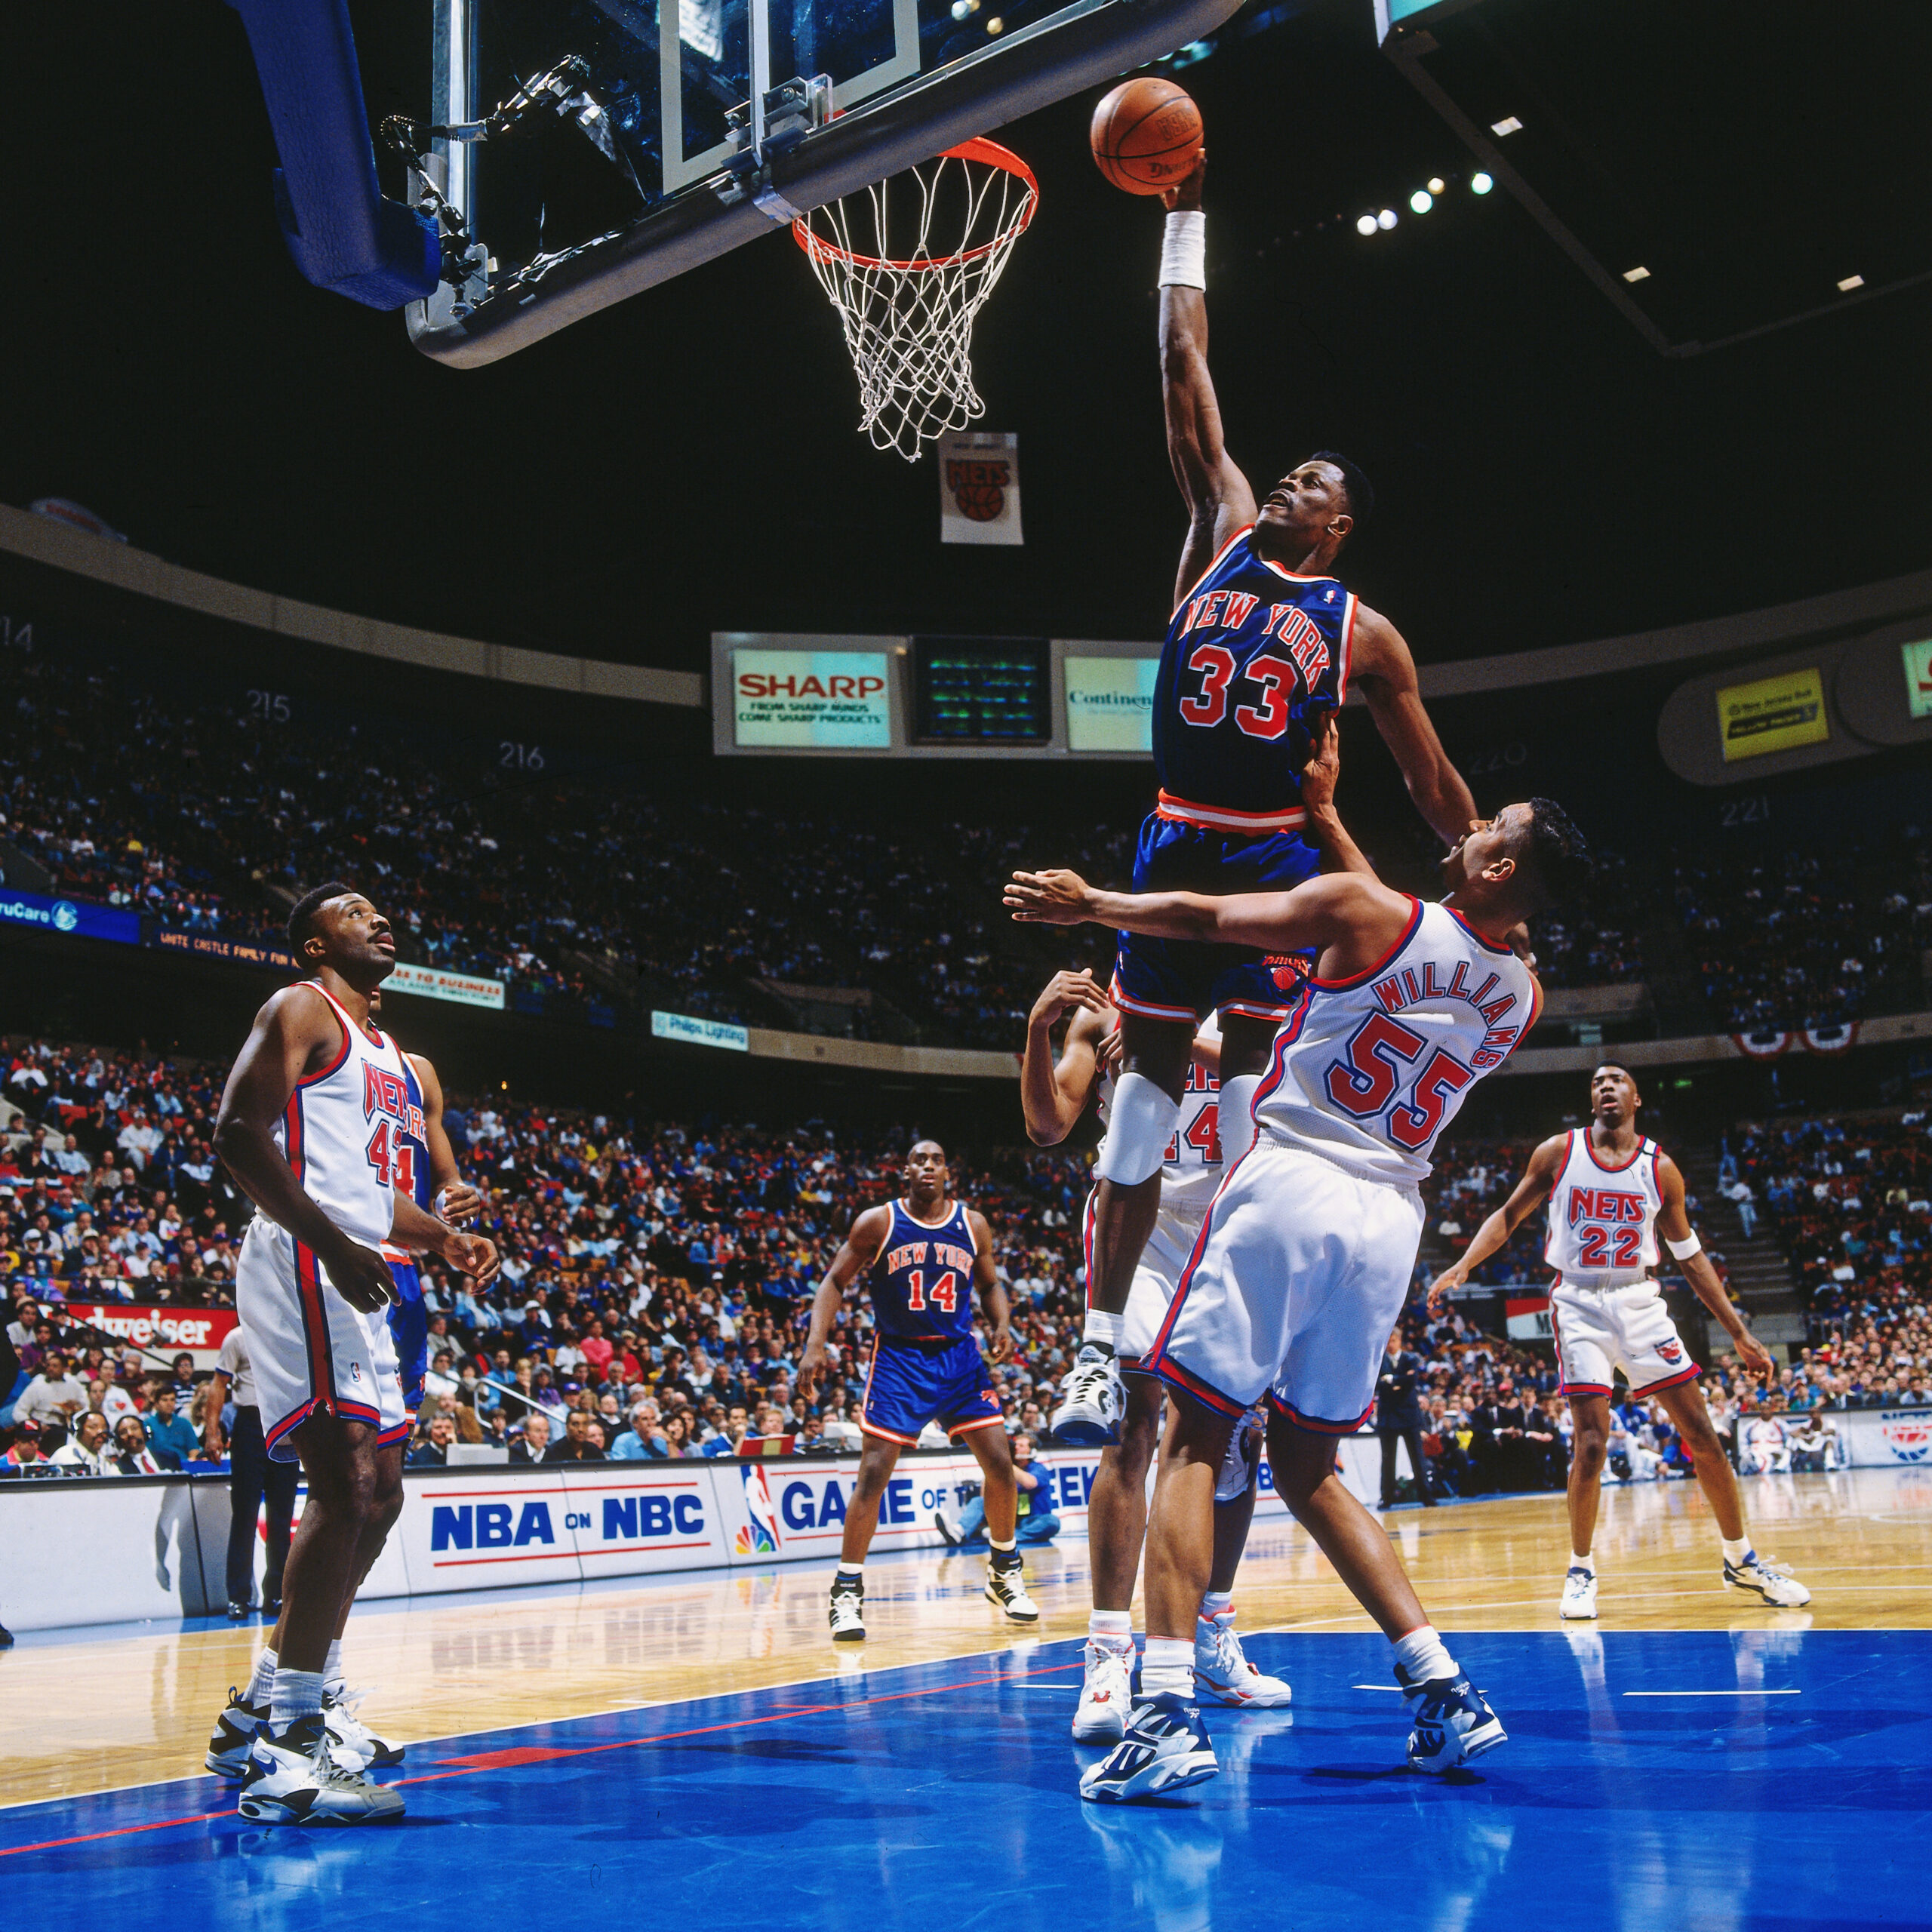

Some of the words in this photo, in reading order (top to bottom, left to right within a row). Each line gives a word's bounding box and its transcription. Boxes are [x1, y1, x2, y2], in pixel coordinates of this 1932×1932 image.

[946, 460, 1011, 493] NETS
[0, 615, 33, 652] 14
[1177, 589, 1260, 641] NEW
[1261, 602, 1331, 694] YORK
[739, 674, 884, 698] SHARP
[1179, 643, 1299, 741] 33
[246, 689, 291, 723] 215
[738, 712, 771, 721] COME
[777, 713, 816, 722] SHARP
[819, 714, 881, 724] PRODUCTS
[750, 703, 785, 712] FROM
[789, 703, 828, 712] SHARP
[498, 741, 545, 771] 216
[1721, 795, 1770, 827] 221
[193, 937, 229, 956] CASTLE
[1370, 960, 1520, 1069] WILLIAMS
[1322, 1006, 1477, 1153] 55
[1567, 1184, 1648, 1230] NETS
[887, 1241, 929, 1276] NEW
[1579, 1223, 1643, 1269] 22
[908, 1269, 958, 1313] 14
[921, 1488, 947, 1510] OF
[431, 1502, 555, 1552] NBA
[565, 1512, 592, 1530] ON
[602, 1494, 705, 1540] NBC
